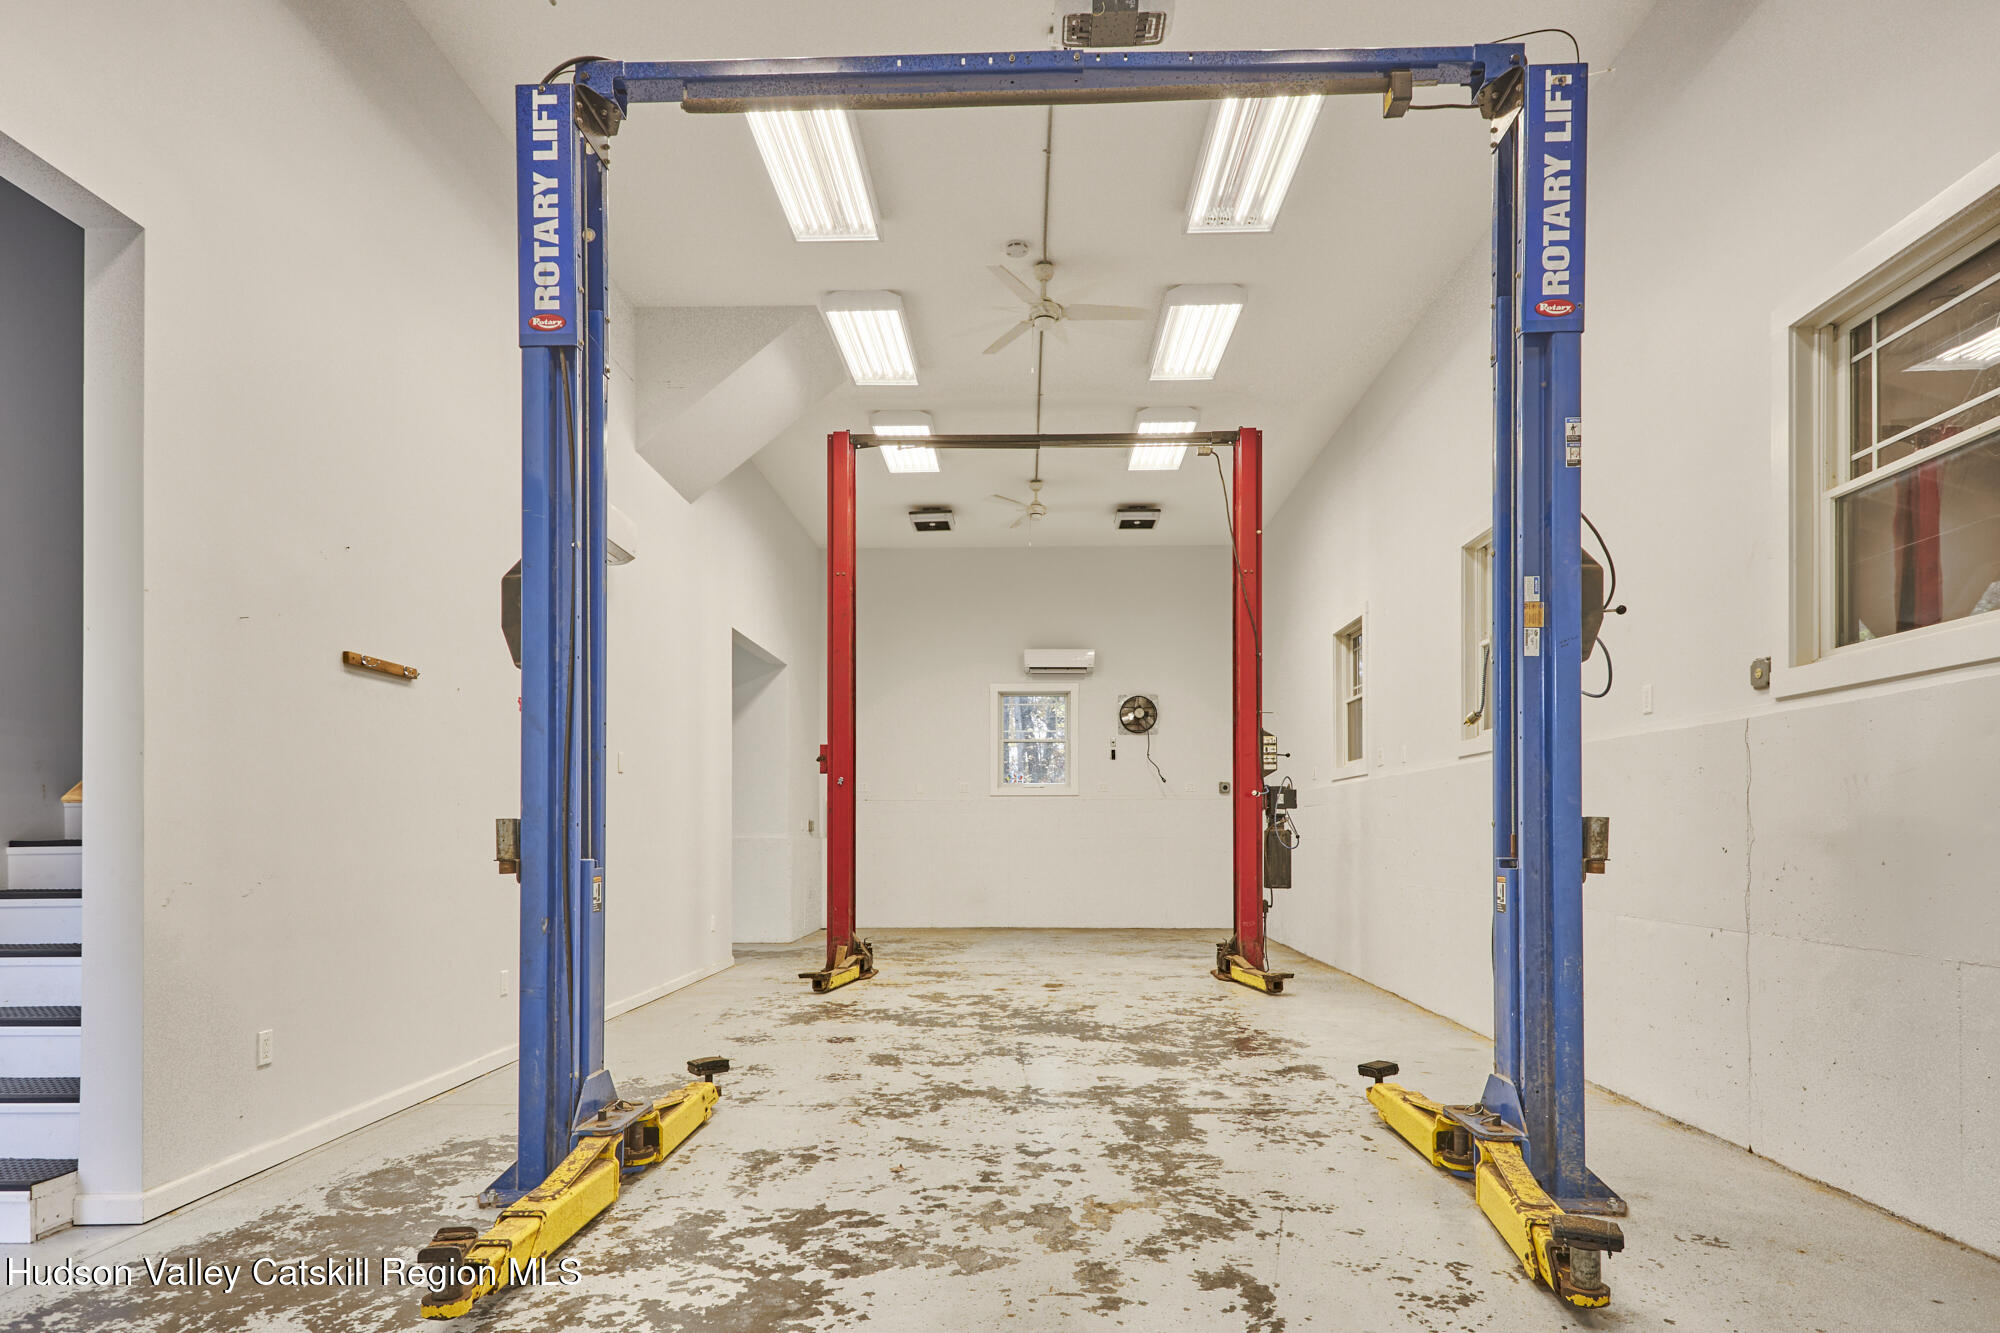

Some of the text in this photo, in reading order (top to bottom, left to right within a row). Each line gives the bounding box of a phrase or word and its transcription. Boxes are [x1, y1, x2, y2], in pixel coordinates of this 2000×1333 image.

[532, 89, 560, 310] ROTARY LIFT
[1541, 69, 1573, 296] ROTARY LIFT
[532, 317, 562, 328] Rotary
[1539, 303, 1571, 314] Rotary
